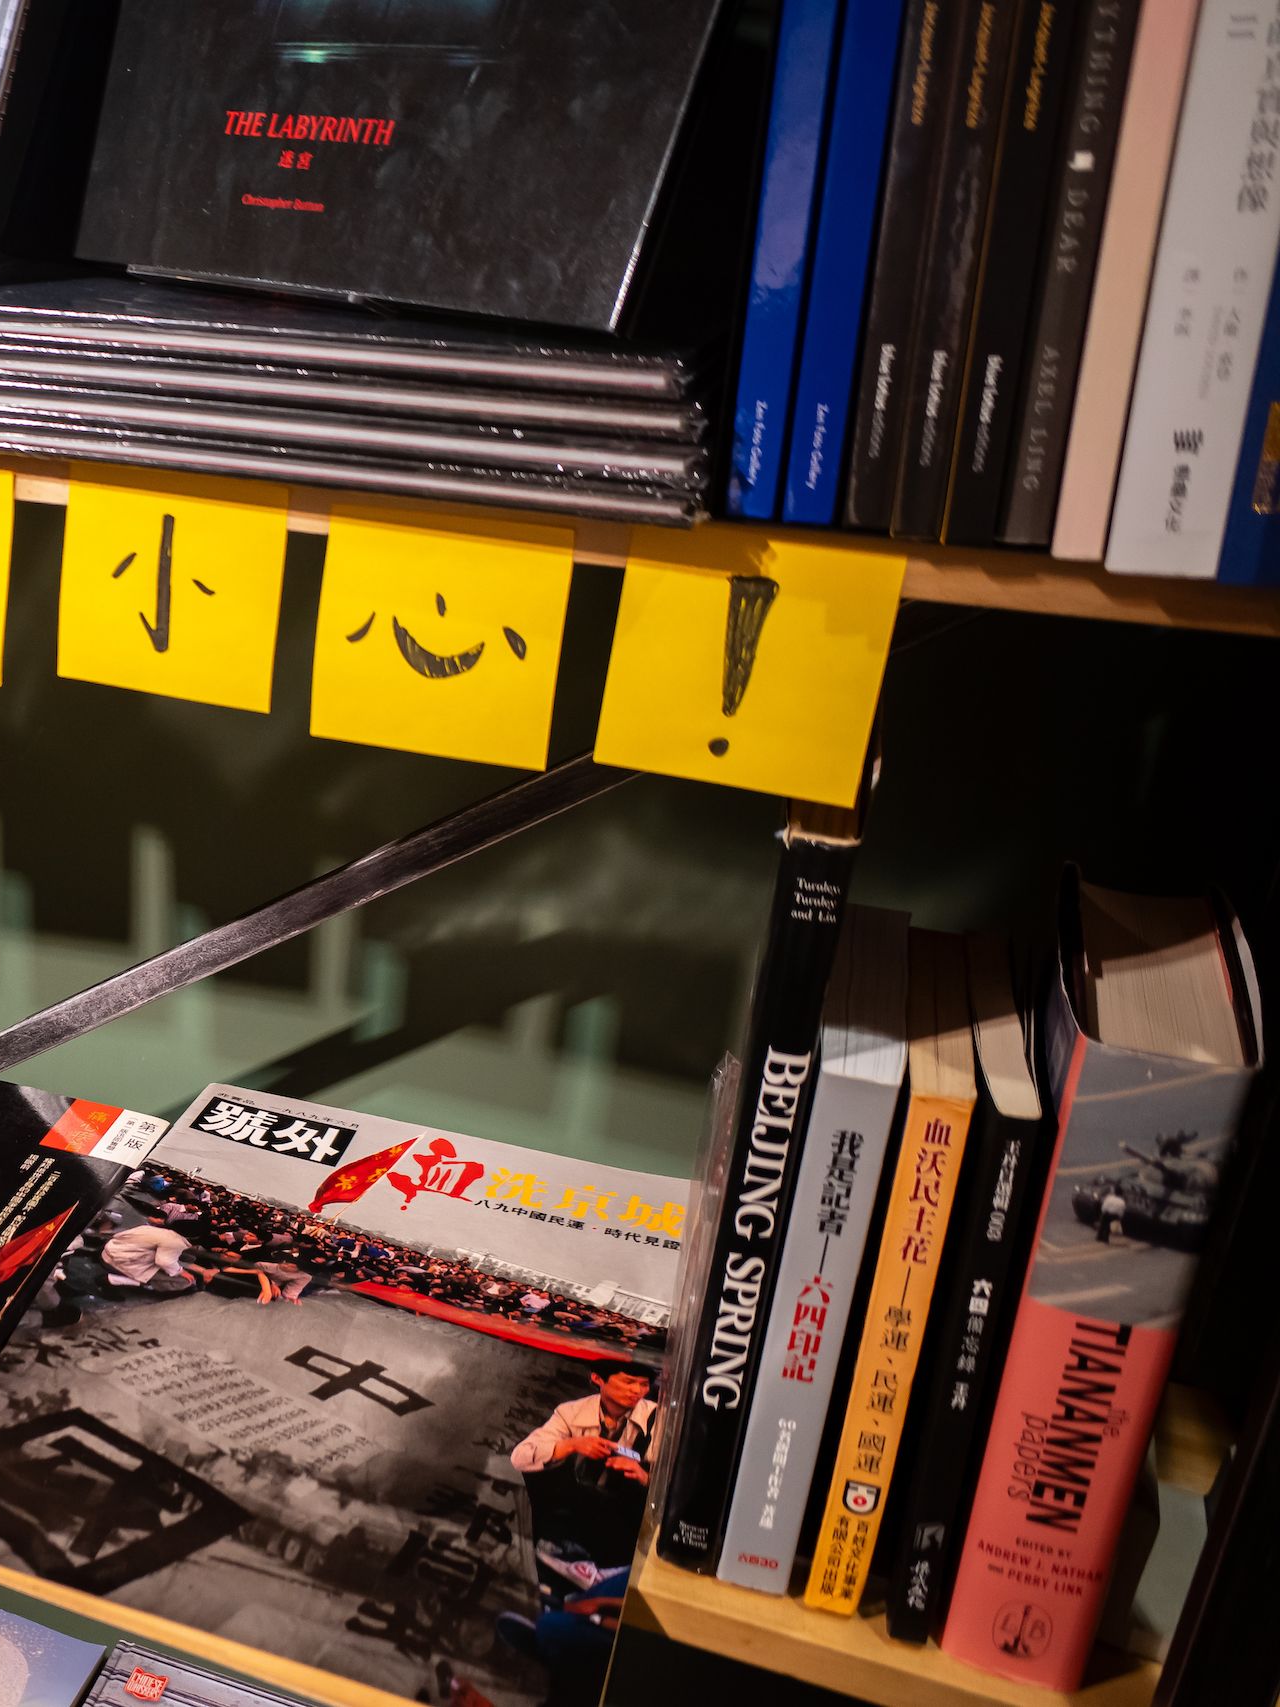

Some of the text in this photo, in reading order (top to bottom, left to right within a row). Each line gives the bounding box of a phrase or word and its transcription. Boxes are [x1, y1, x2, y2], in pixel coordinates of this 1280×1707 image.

[224, 110, 396, 145] THE LABYRINTH
[277, 149, 314, 170] 迷宮
[1033, 345, 1059, 414] AXEL
[791, 909, 813, 921] and
[124, 1120, 157, 1150] 第二版
[199, 1101, 340, 1165] 號外
[387, 1138, 686, 1239] 血洗京城
[818, 1129, 864, 1237] 我是記者
[899, 1117, 952, 1265] 血沃民主花
[703, 1045, 811, 1411] BEIJING SPRING
[782, 1275, 834, 1383] 六四印記
[284, 1345, 436, 1417] 中
[1007, 1411, 1048, 1502] papers
[1026, 1321, 1132, 1535] TIANANMEN
[977, 1540, 1033, 1567] ANDREW
[1051, 1561, 1103, 1583] NATHAN
[1016, 1536, 1053, 1554] EDITED
[1008, 1569, 1048, 1589] PERRY
[1054, 1581, 1083, 1597] LINK
